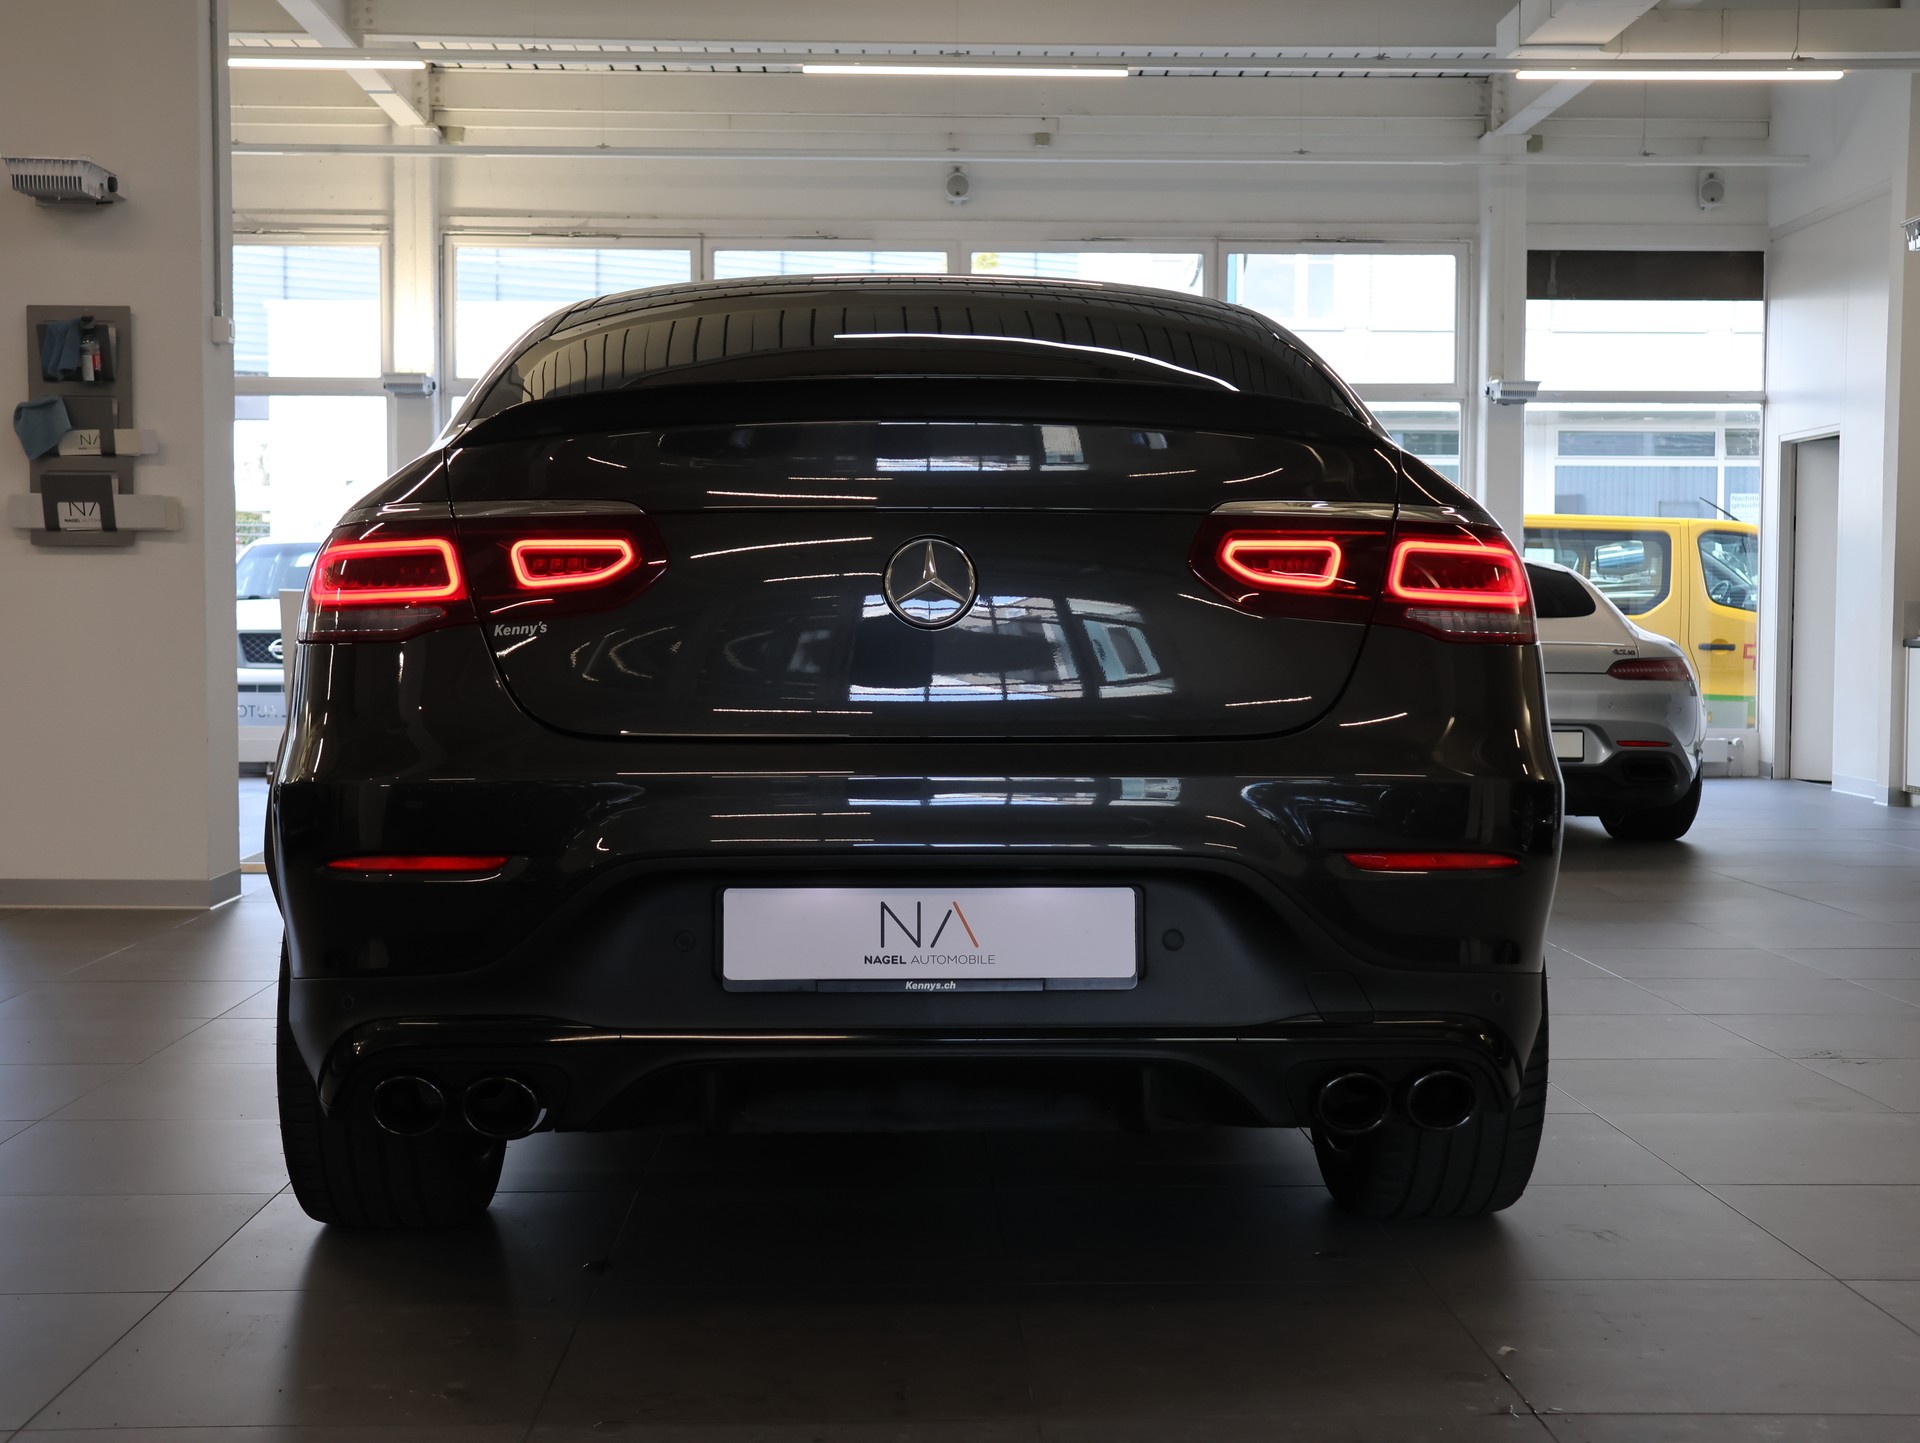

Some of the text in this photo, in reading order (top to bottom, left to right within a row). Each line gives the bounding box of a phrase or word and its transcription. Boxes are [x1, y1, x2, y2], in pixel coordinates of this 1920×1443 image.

[494, 621, 548, 637] Kenny's
[864, 954, 996, 965] NAGEL AUTOMOBILE
[905, 980, 957, 992] Kennys.ch
